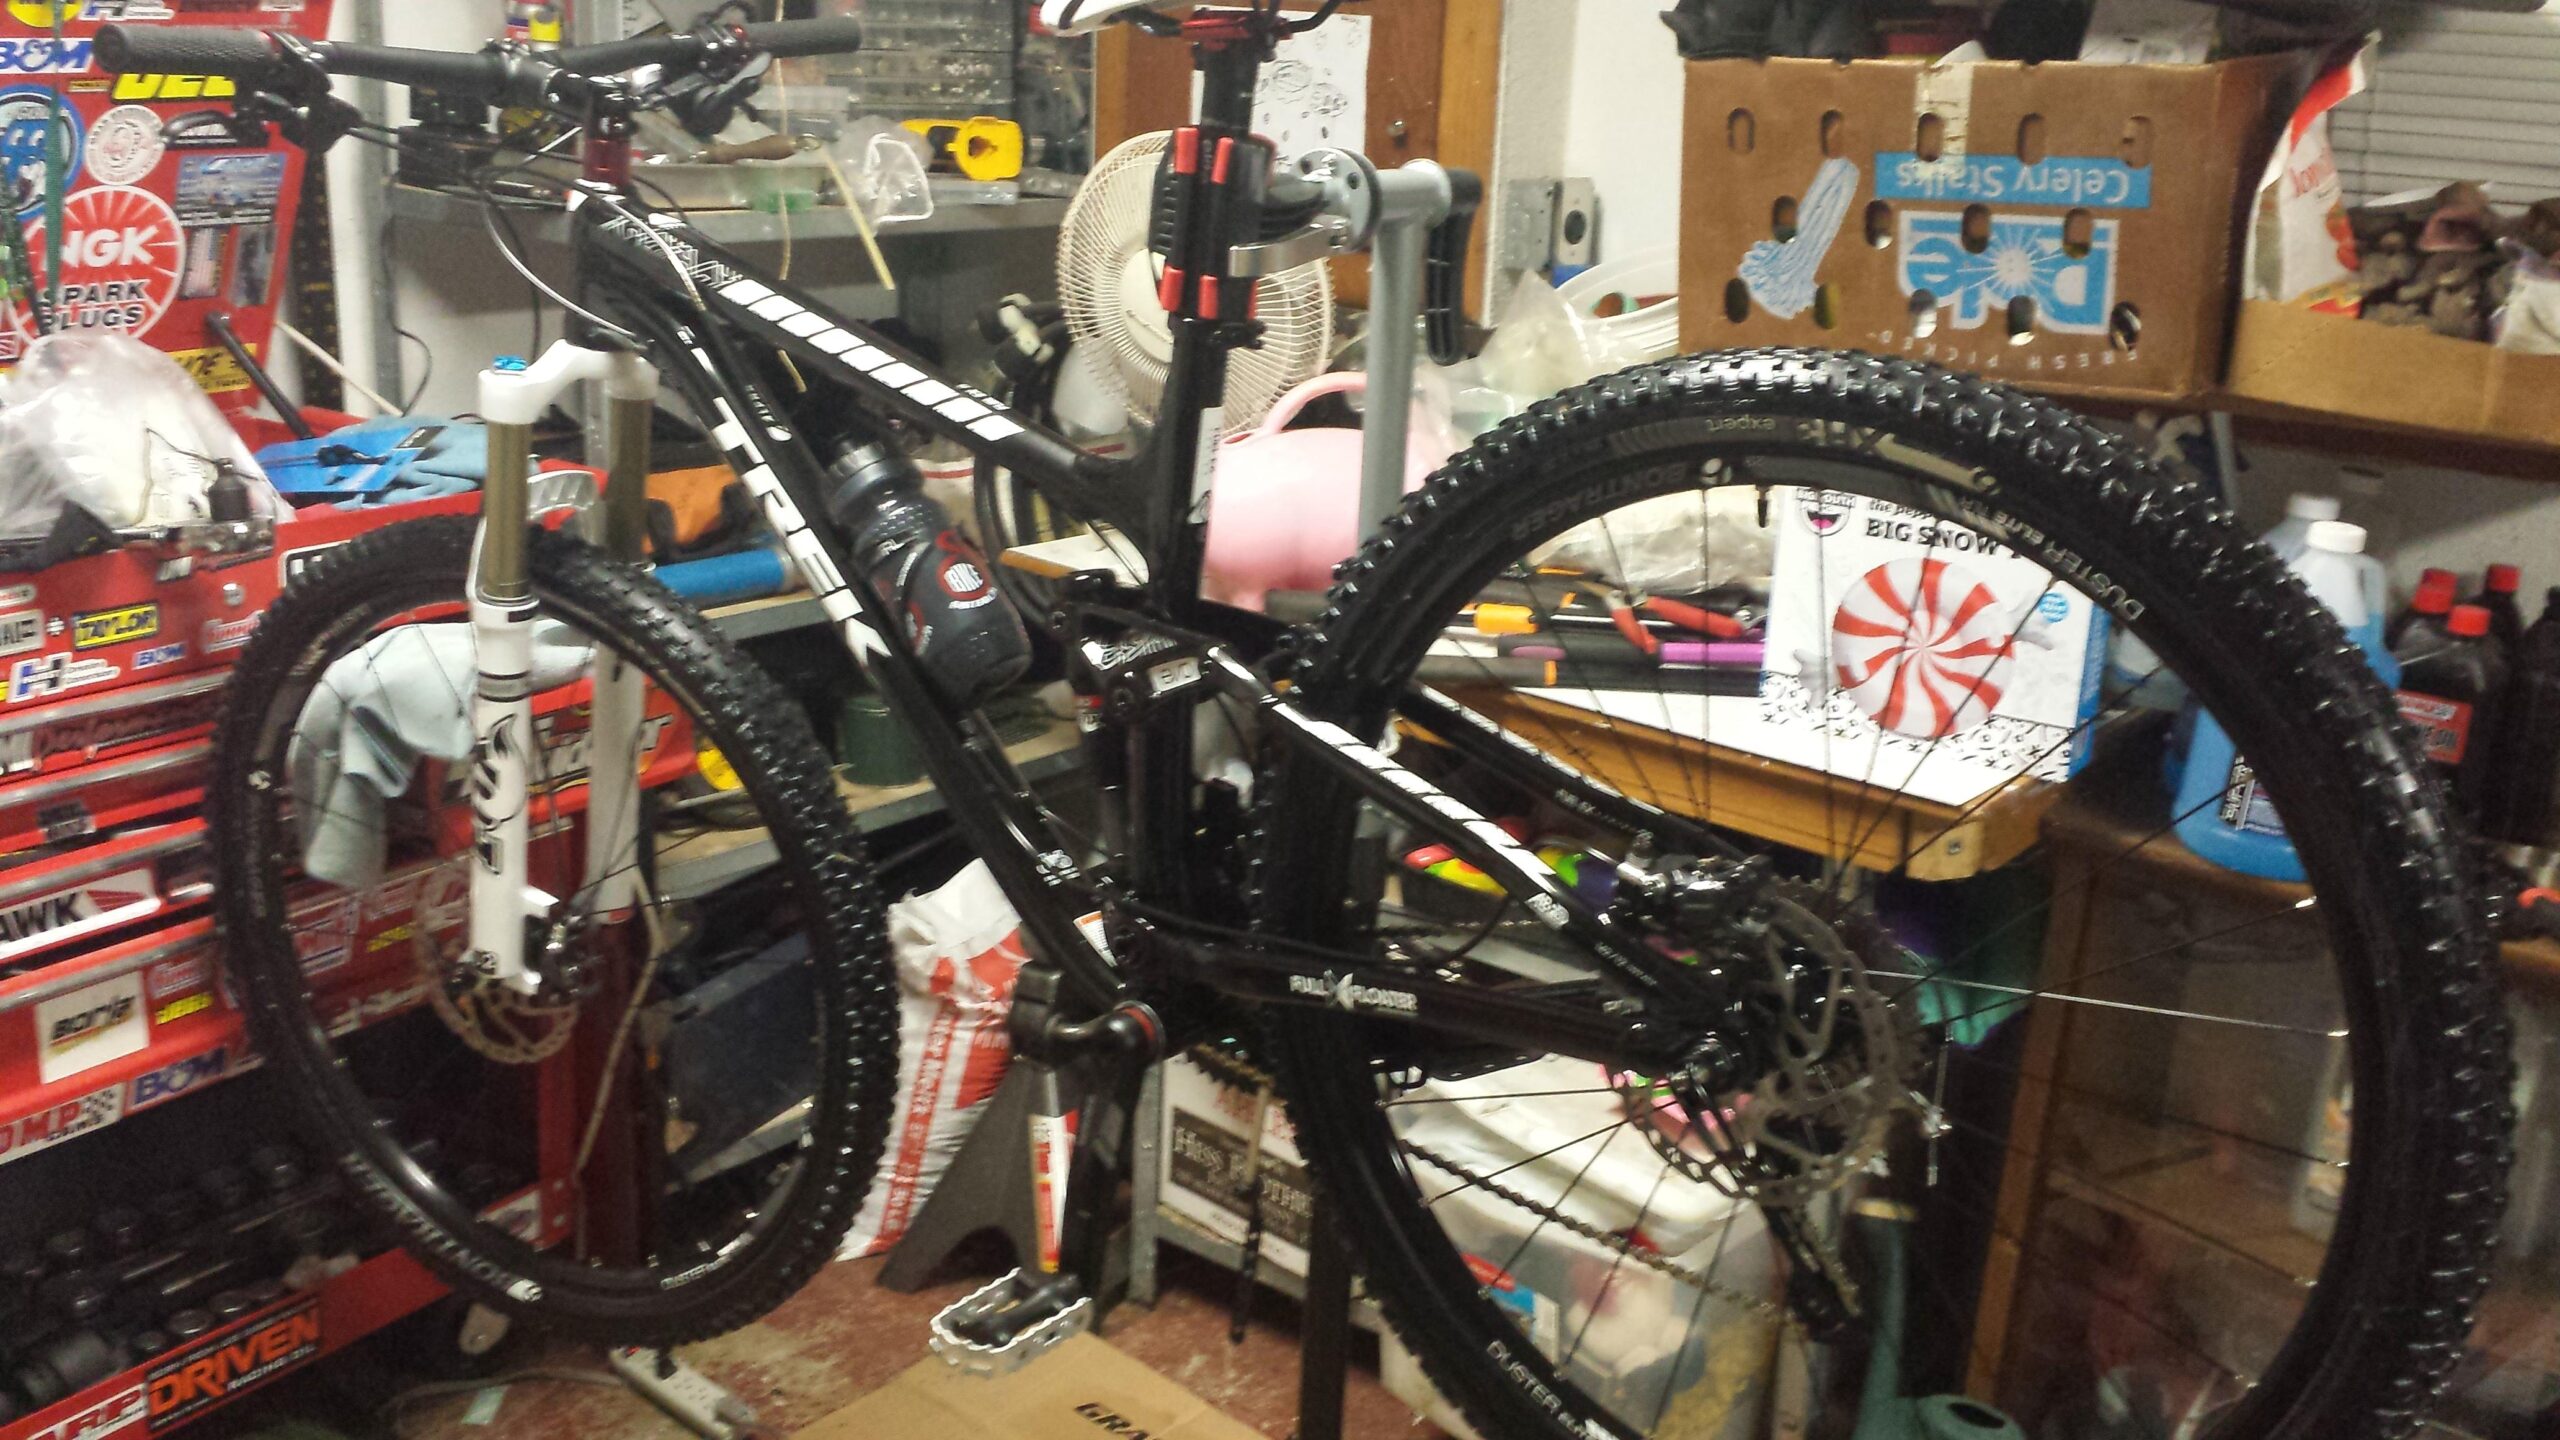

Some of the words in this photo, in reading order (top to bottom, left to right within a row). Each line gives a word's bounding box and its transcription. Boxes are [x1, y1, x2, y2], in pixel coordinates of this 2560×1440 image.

[1895, 162, 2005, 197] Stalks
[2014, 167, 2131, 203] Celery
[711, 396, 893, 667] TREK
[1866, 518, 1912, 544] BIG
[2039, 540, 2147, 621] DUSTER
[149, 1308, 321, 1416] DRIVEN
